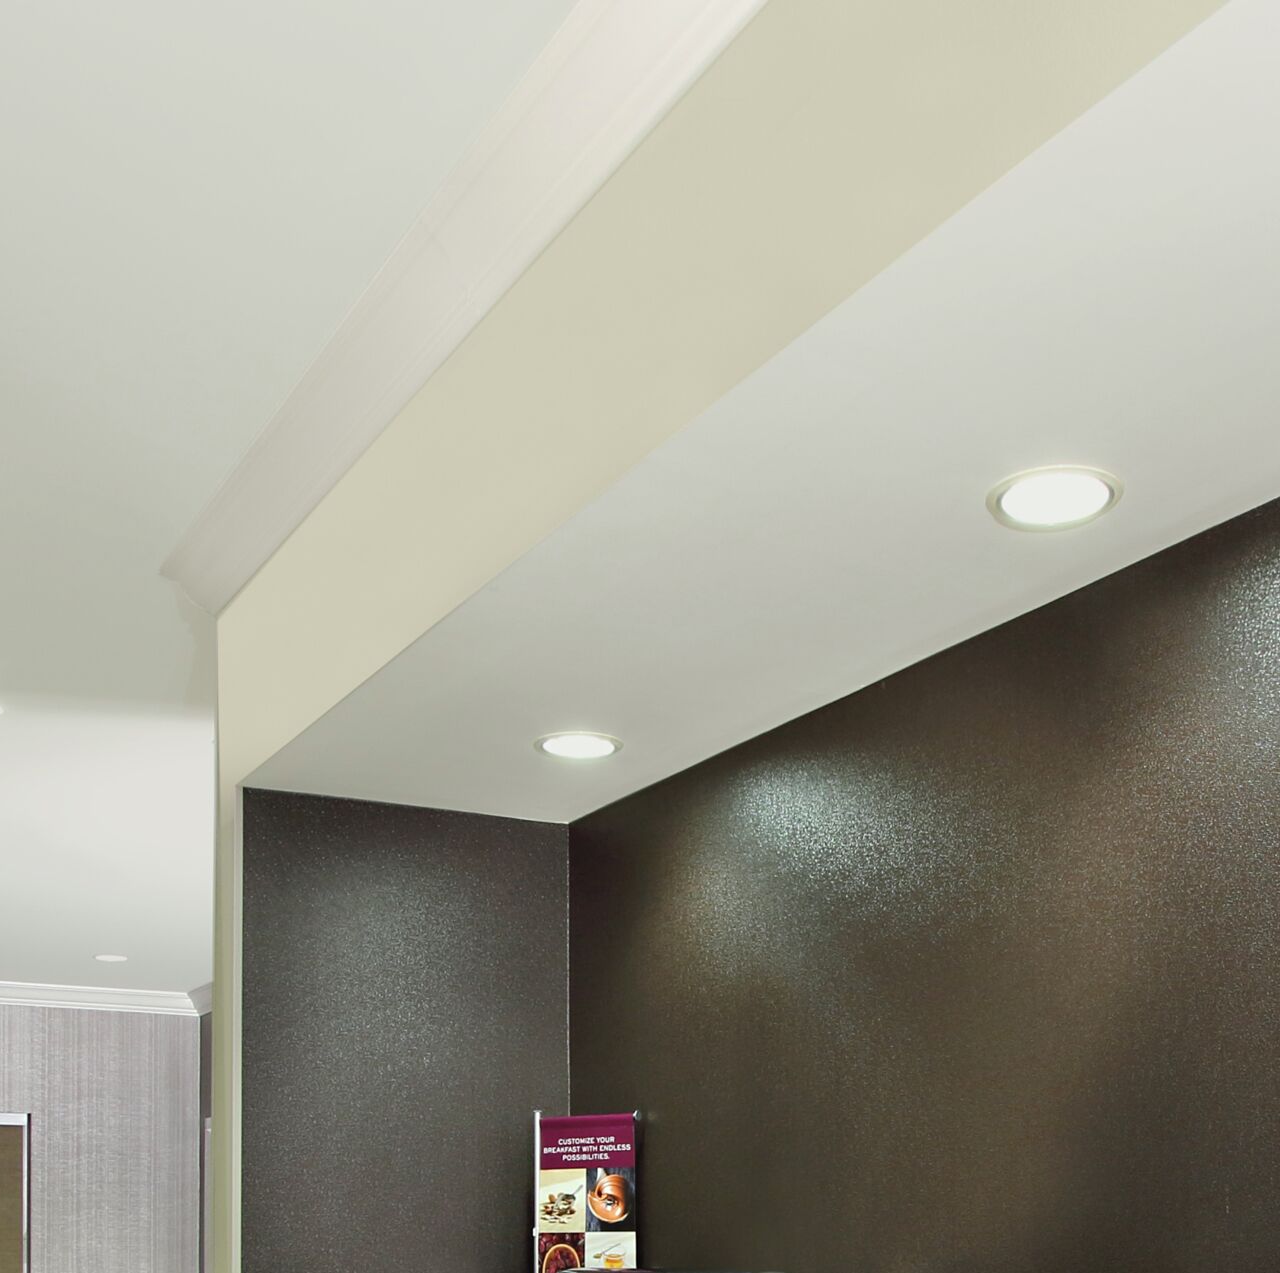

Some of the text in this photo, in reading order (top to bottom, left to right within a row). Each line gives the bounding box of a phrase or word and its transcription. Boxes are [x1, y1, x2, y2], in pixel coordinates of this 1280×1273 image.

[558, 1136, 615, 1145] CUSTOMIZE YOUR
[543, 1146, 580, 1154] BREAKFAST
[562, 1153, 610, 1161] POSSIBILITIES.
